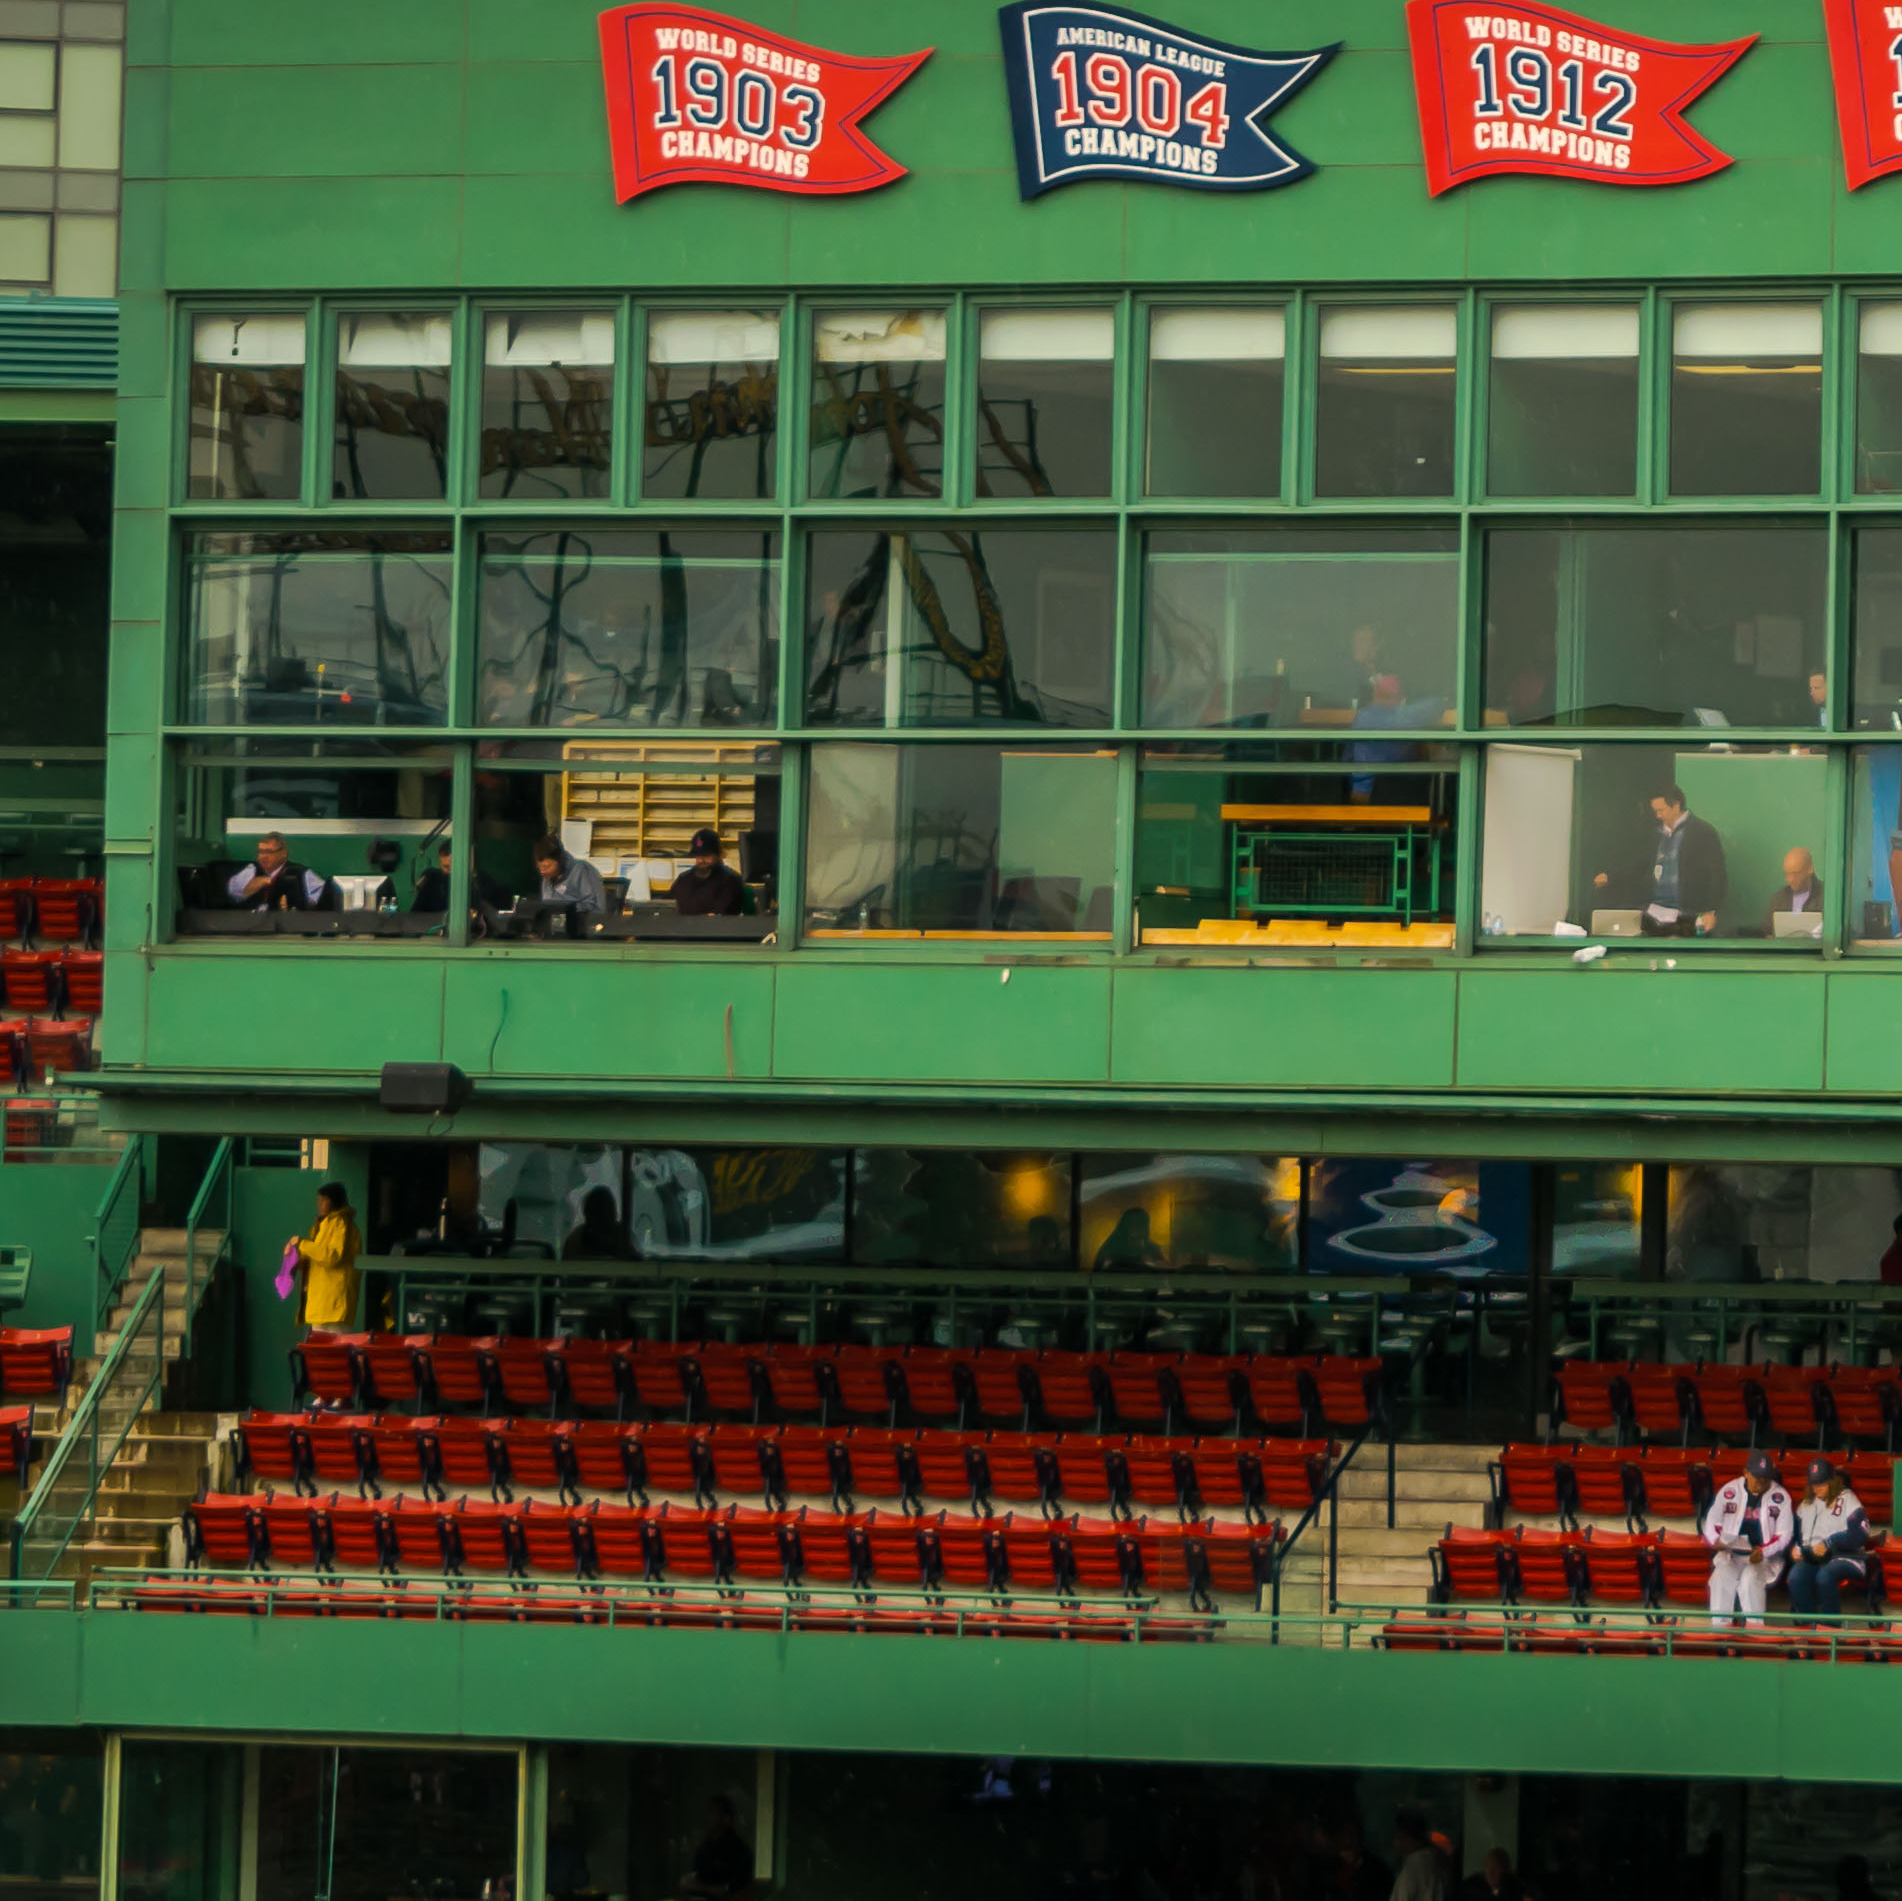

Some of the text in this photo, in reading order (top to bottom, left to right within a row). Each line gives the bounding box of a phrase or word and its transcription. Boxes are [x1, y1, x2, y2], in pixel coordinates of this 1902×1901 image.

[656, 27, 821, 83] WORLD SERIES
[1056, 26, 1226, 78] AMERICAN LEAGUE
[1465, 15, 1641, 74] WORLD SERIES
[653, 55, 825, 151] 1903
[1052, 51, 1230, 148] 1904
[1473, 42, 1638, 140] 1912
[661, 130, 810, 178] CHAMPIONS
[1064, 128, 1218, 175] CHAMPIONS
[1473, 121, 1630, 170] CHAMPIONS
